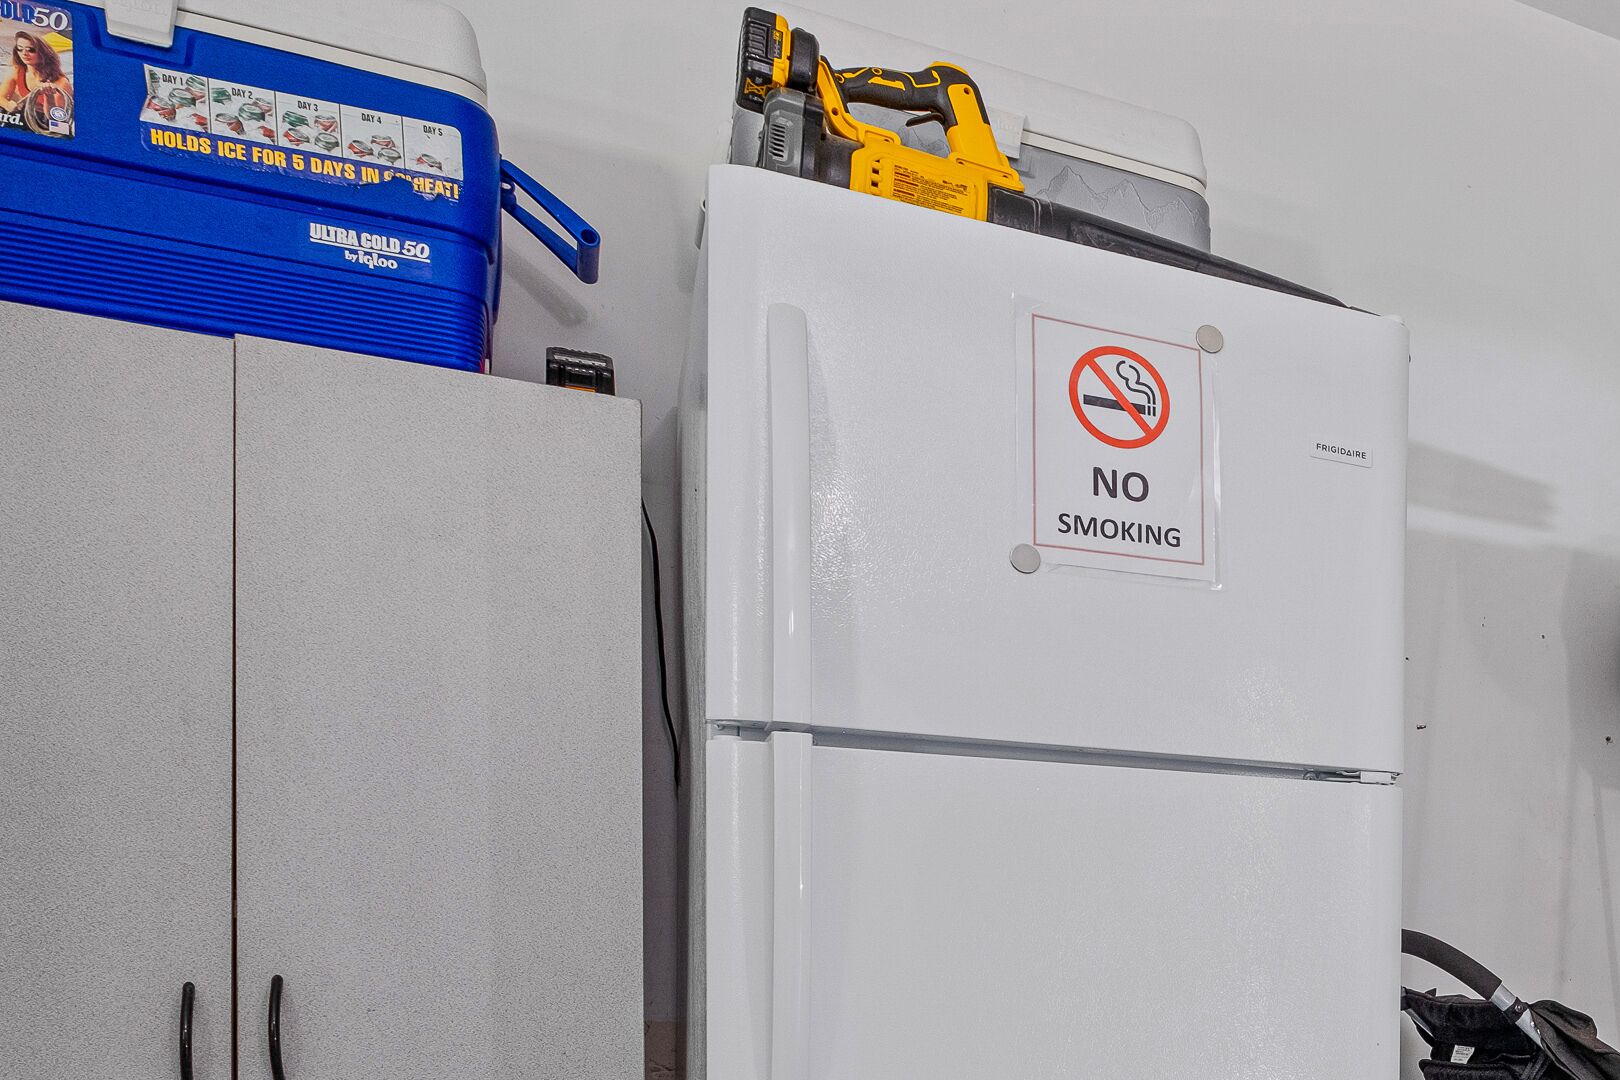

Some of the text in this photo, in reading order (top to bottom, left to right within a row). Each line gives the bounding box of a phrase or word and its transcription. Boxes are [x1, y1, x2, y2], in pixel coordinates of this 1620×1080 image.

[0, 0, 69, 31] OLD 50
[162, 73, 183, 86] DAY 1
[231, 87, 254, 100] DAY 2
[297, 100, 319, 112] DAY 3
[361, 113, 382, 124] DAY 4
[423, 125, 444, 137] DAY 5
[150, 128, 212, 155] HOLDS
[217, 140, 247, 161] ICE
[252, 146, 287, 168] FOR
[292, 153, 305, 171] 5
[310, 157, 356, 180] DAYS
[361, 166, 380, 184] IN
[413, 177, 459, 200] HEAT!
[309, 222, 430, 259] ULTRA COLD 50
[344, 250, 358, 263] by
[1316, 443, 1367, 460] FRIGIDAIRE
[1092, 466, 1150, 502] NO
[1057, 513, 1181, 548] SMOKING
